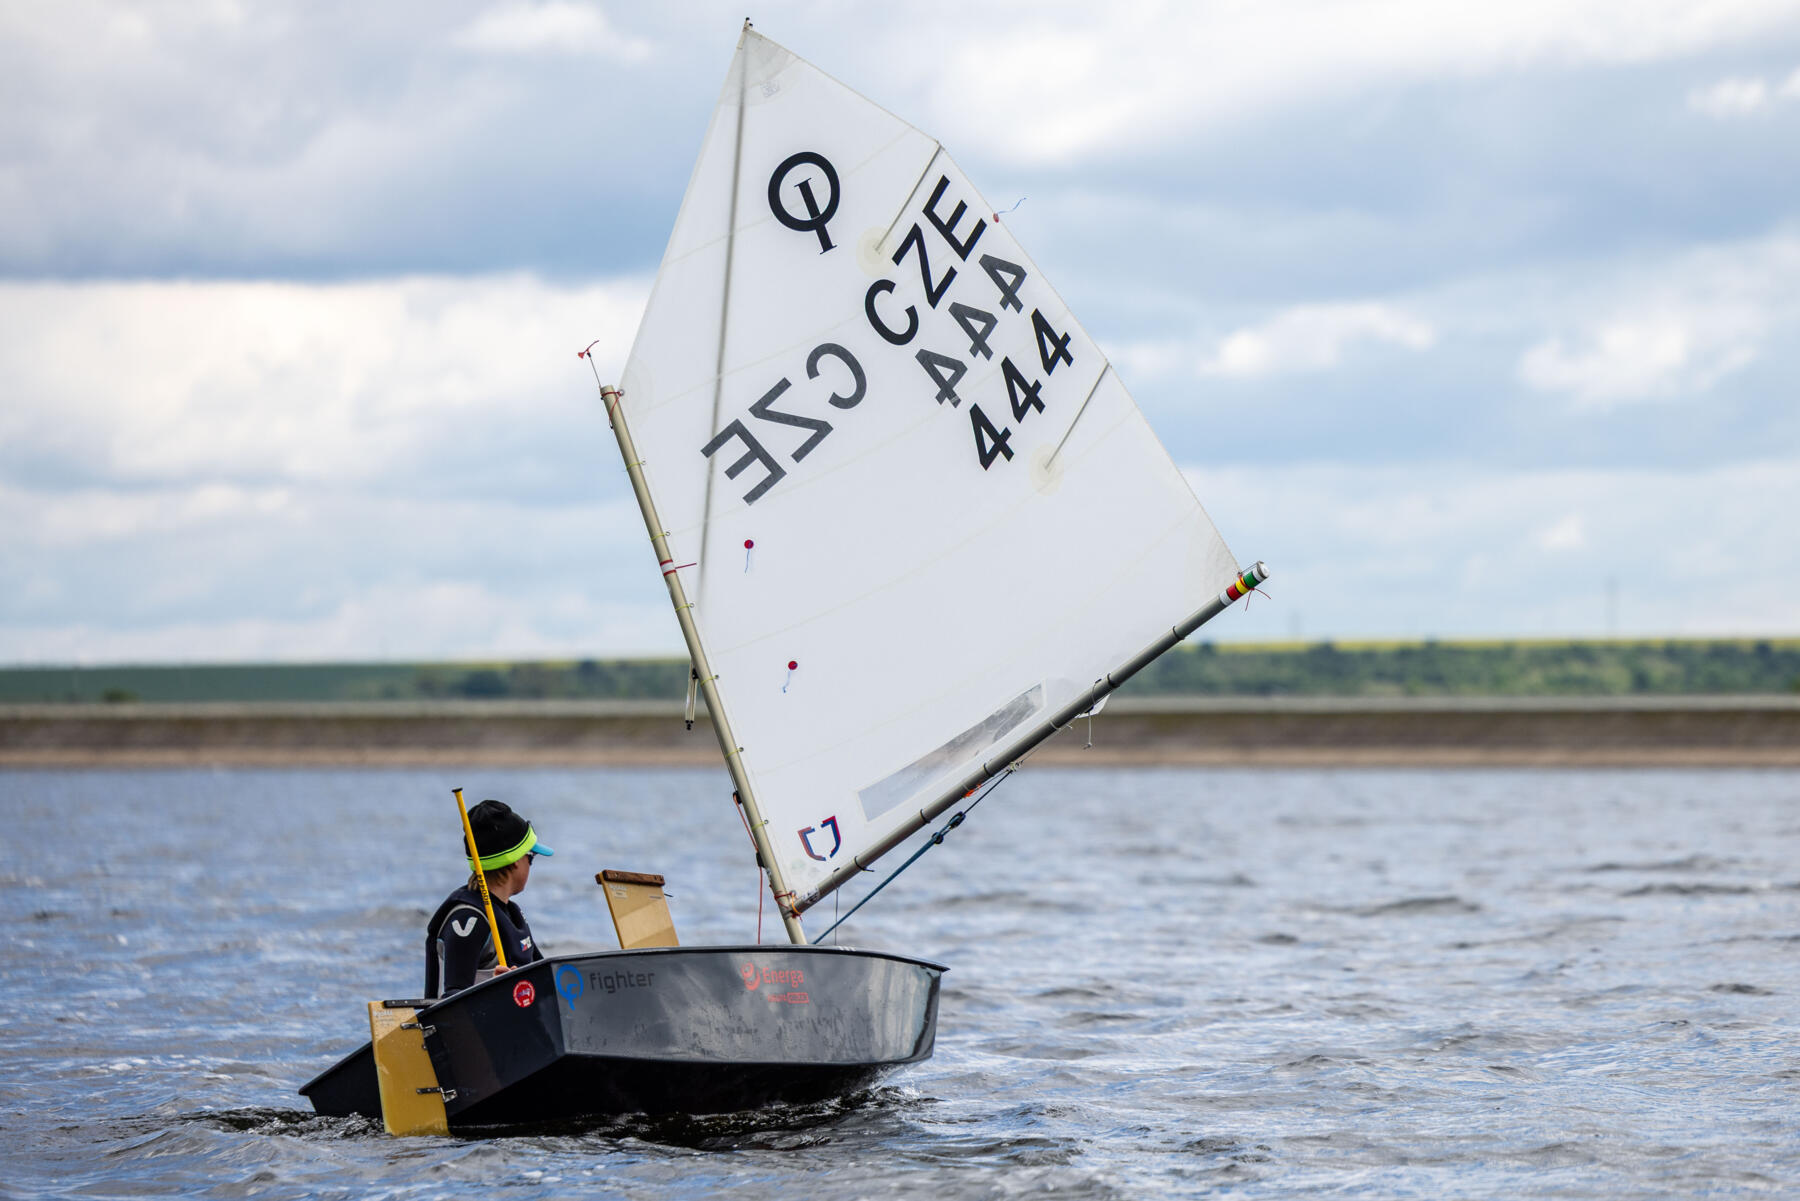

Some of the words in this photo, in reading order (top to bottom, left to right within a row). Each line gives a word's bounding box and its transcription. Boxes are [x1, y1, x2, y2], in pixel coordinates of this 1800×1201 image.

[864, 174, 987, 346] CZE
[968, 307, 1074, 471] 444
[589, 970, 656, 994] fighter
[762, 967, 804, 988] Energa
